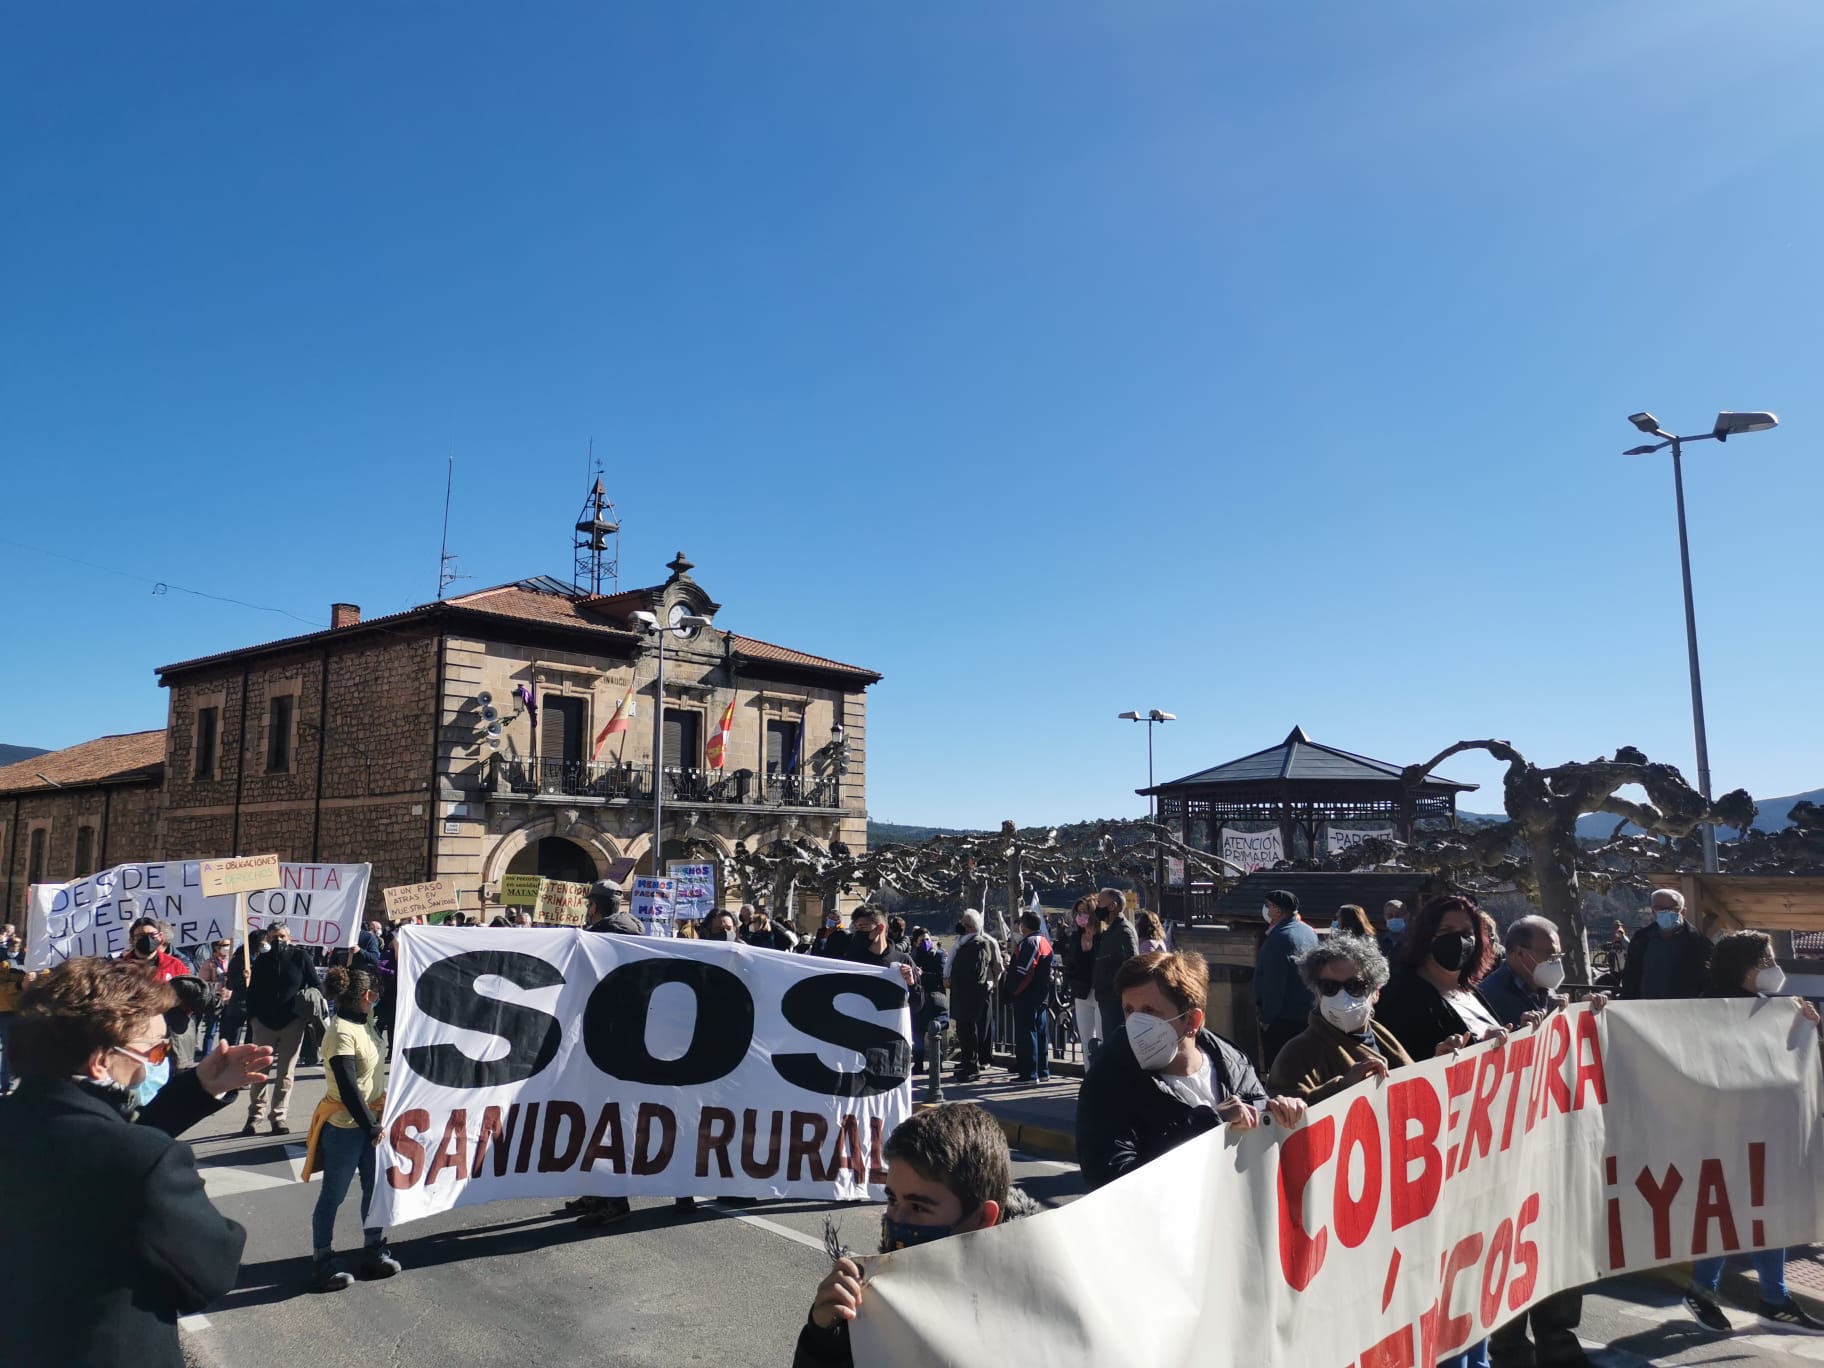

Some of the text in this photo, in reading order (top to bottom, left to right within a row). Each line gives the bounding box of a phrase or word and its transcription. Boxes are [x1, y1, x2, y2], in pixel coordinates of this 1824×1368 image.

[1223, 833, 1281, 850] ATENCIÓN
[1224, 848, 1282, 864] PRIMARIA
[51, 863, 340, 912] DESDE L NTA
[387, 882, 443, 897] NI UN PASO
[507, 888, 538, 897] MATAN
[637, 879, 673, 890] MENOS
[425, 891, 436, 899] EN
[541, 893, 582, 908] PRIMARIA
[49, 890, 312, 939] JUEGAN CON
[391, 903, 427, 916] NUESTRA
[50, 916, 341, 966] NUERA SUD
[401, 950, 910, 1098] SOS
[385, 1100, 677, 1190] SANIDAD
[1276, 1009, 1608, 1293] COBERTURA
[1605, 1141, 1767, 1271] ¡YA!
